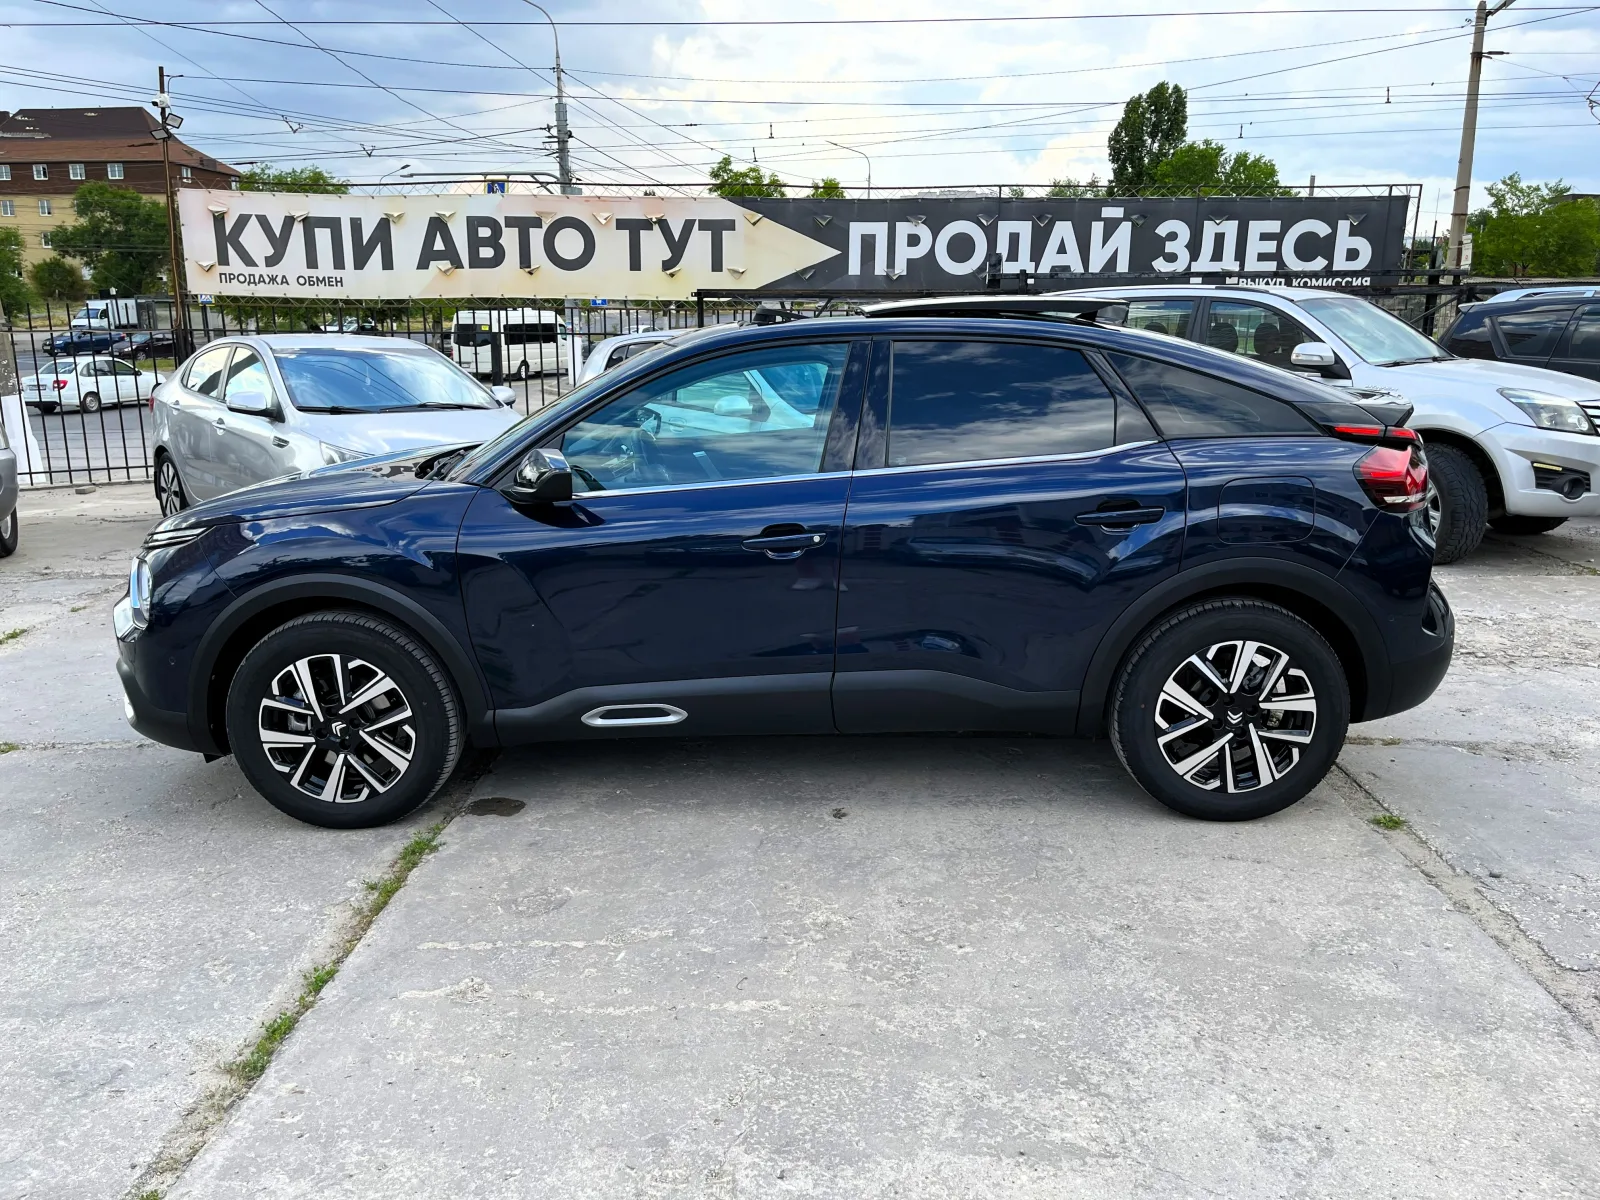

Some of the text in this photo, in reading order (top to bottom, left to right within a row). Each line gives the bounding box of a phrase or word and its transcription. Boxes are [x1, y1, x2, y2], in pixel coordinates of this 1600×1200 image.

[213, 213, 736, 273] КУПИ АВТО ТУТ
[848, 207, 1372, 284] ПРОДАЙ ЗДЕСЬ
[219, 272, 344, 288] ПРОДАЖА ОБМЕН
